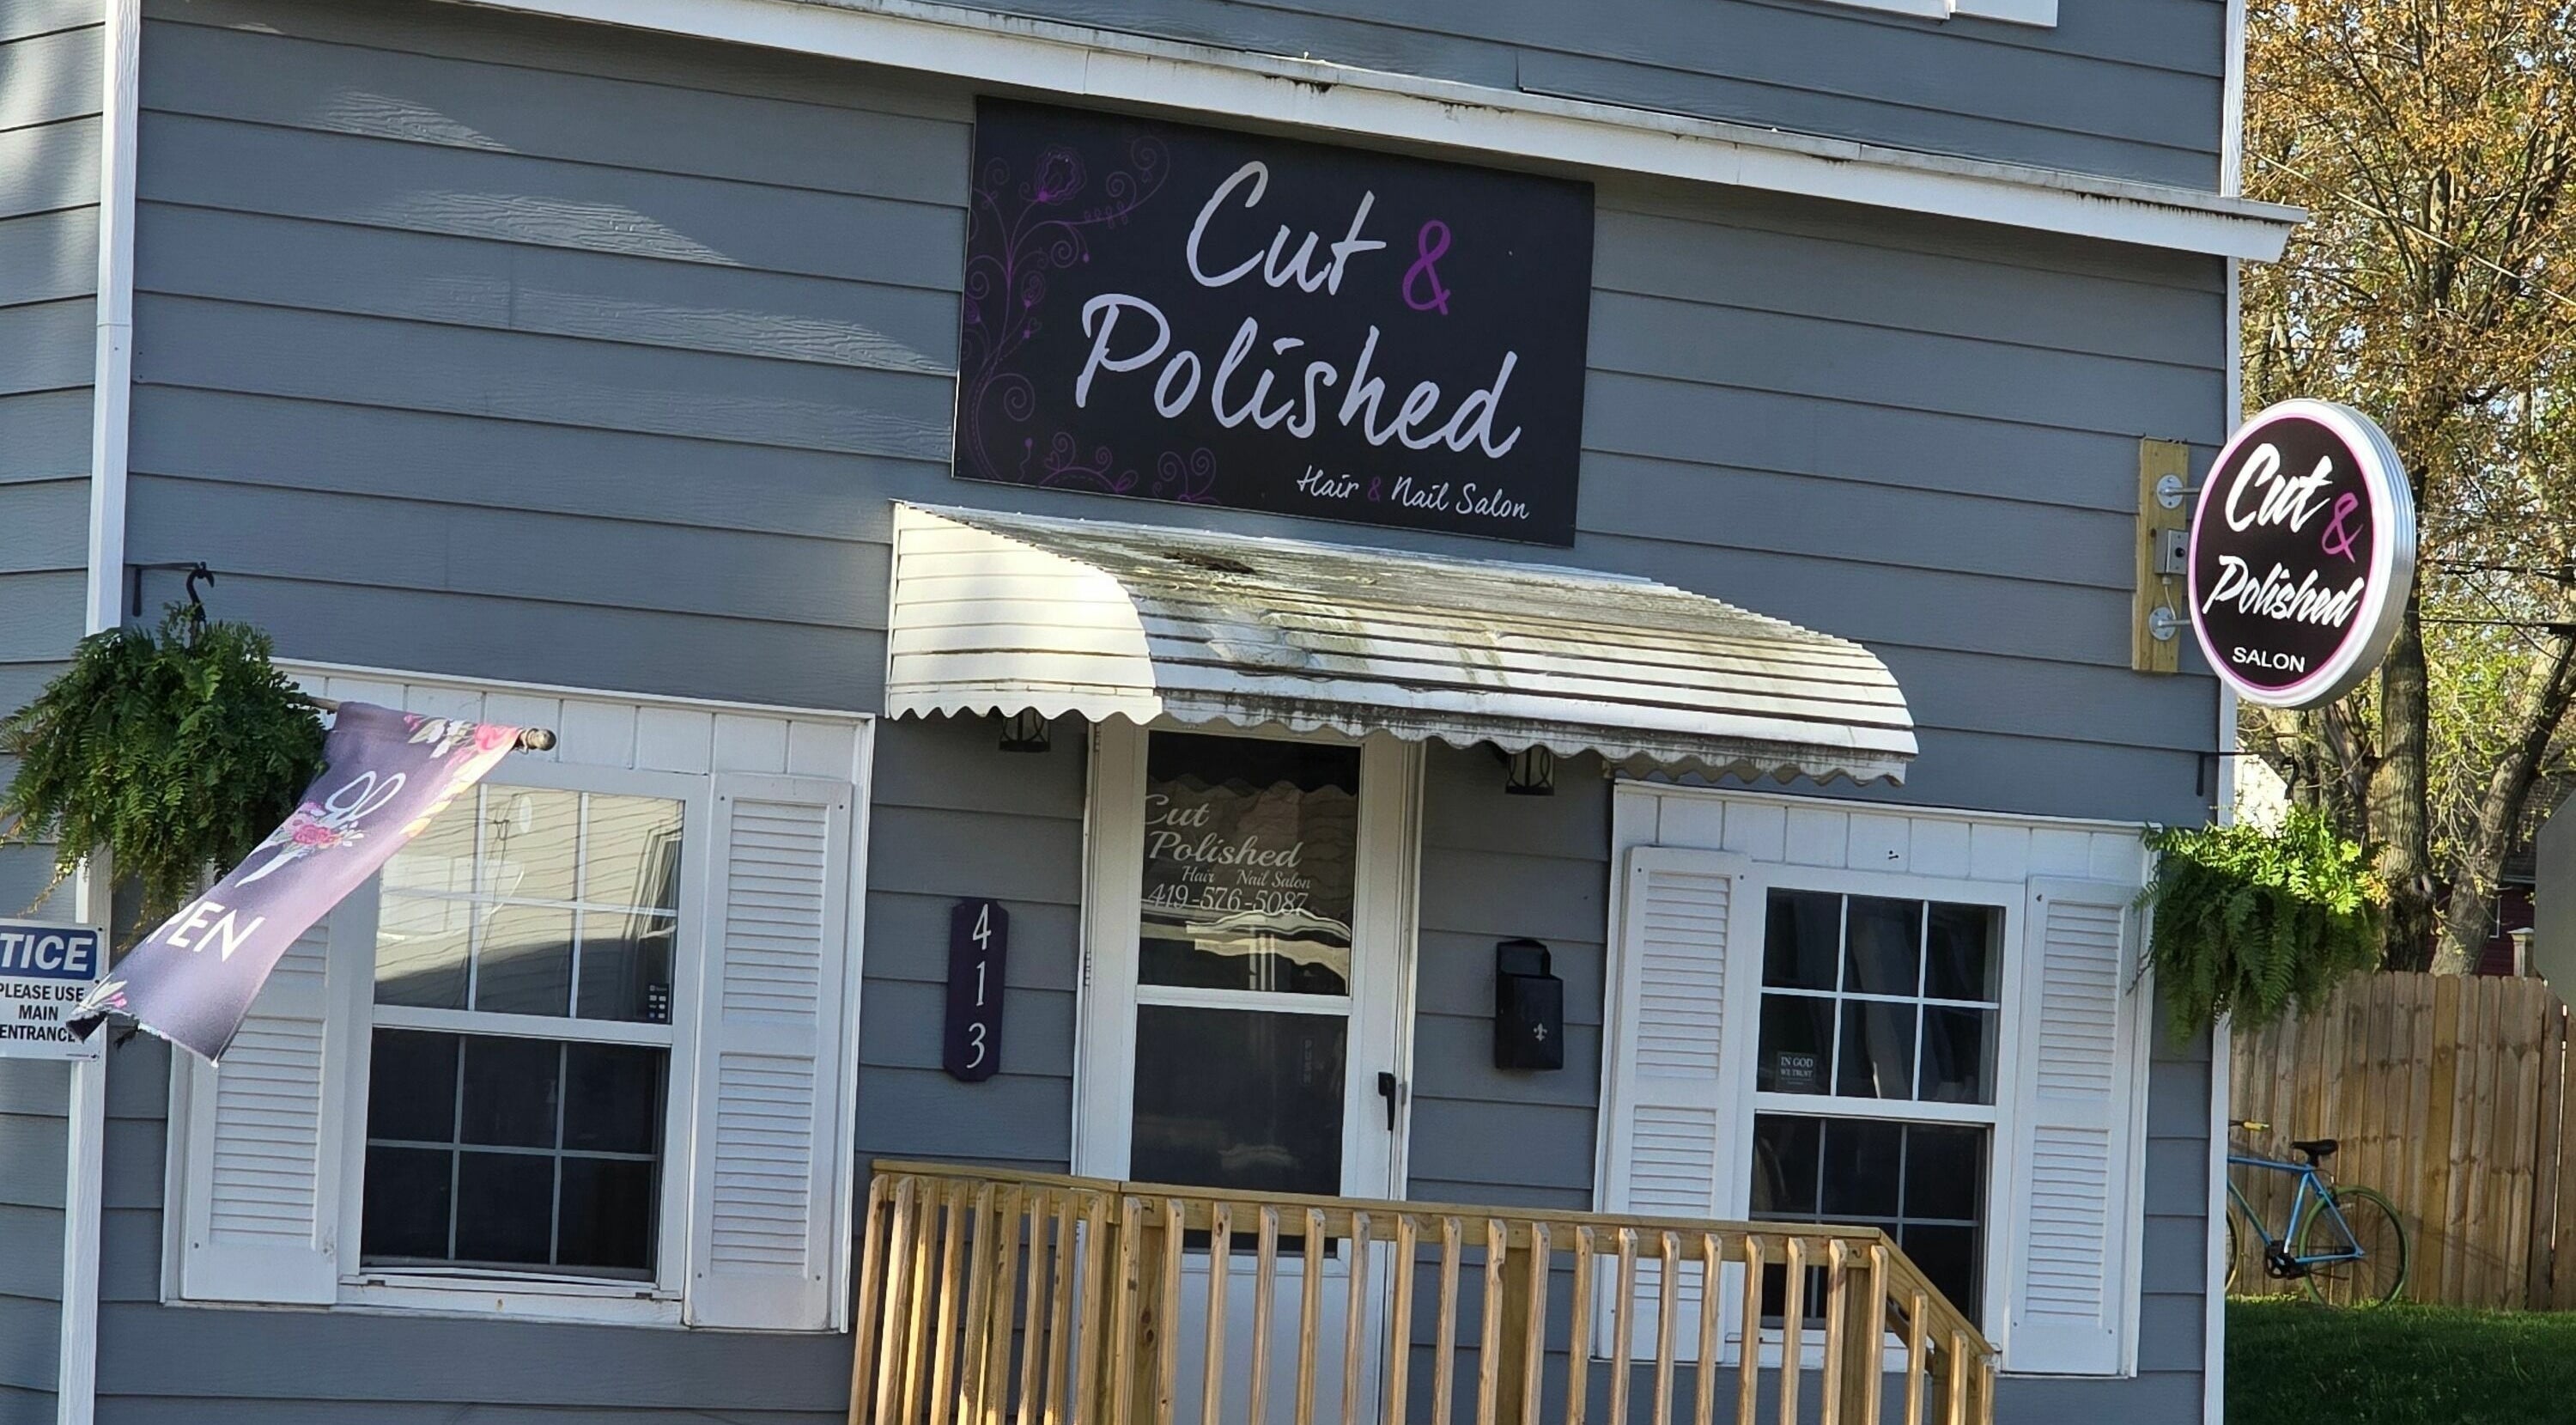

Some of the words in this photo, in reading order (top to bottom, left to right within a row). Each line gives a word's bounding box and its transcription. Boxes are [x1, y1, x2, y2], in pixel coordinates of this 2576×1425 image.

[1186, 161, 1387, 295] Cut
[1401, 220, 1451, 315] &
[1074, 293, 1522, 459] Polished
[1297, 465, 1359, 498] Hair
[1367, 476, 1382, 502] &
[1391, 476, 1449, 511] Nail
[1455, 483, 1530, 520] Salon
[2225, 442, 2333, 533] Cut
[2322, 492, 2363, 563] &
[2202, 554, 2364, 628] Polished
[2232, 647, 2306, 673] SALON
[1148, 831, 1304, 868] Polished
[1182, 865, 1216, 883] Hair
[1236, 869, 1267, 886] Nail
[1272, 871, 1311, 889] Salon
[1148, 883, 1309, 915] 419-576-5087
[0, 933, 93, 971] TICE
[55, 986, 84, 1002] USE
[966, 904, 992, 1069] 413
[19, 1005, 58, 1021] MAIN
[1781, 1057, 1791, 1066] IN
[1793, 1057, 1814, 1068] GOD
